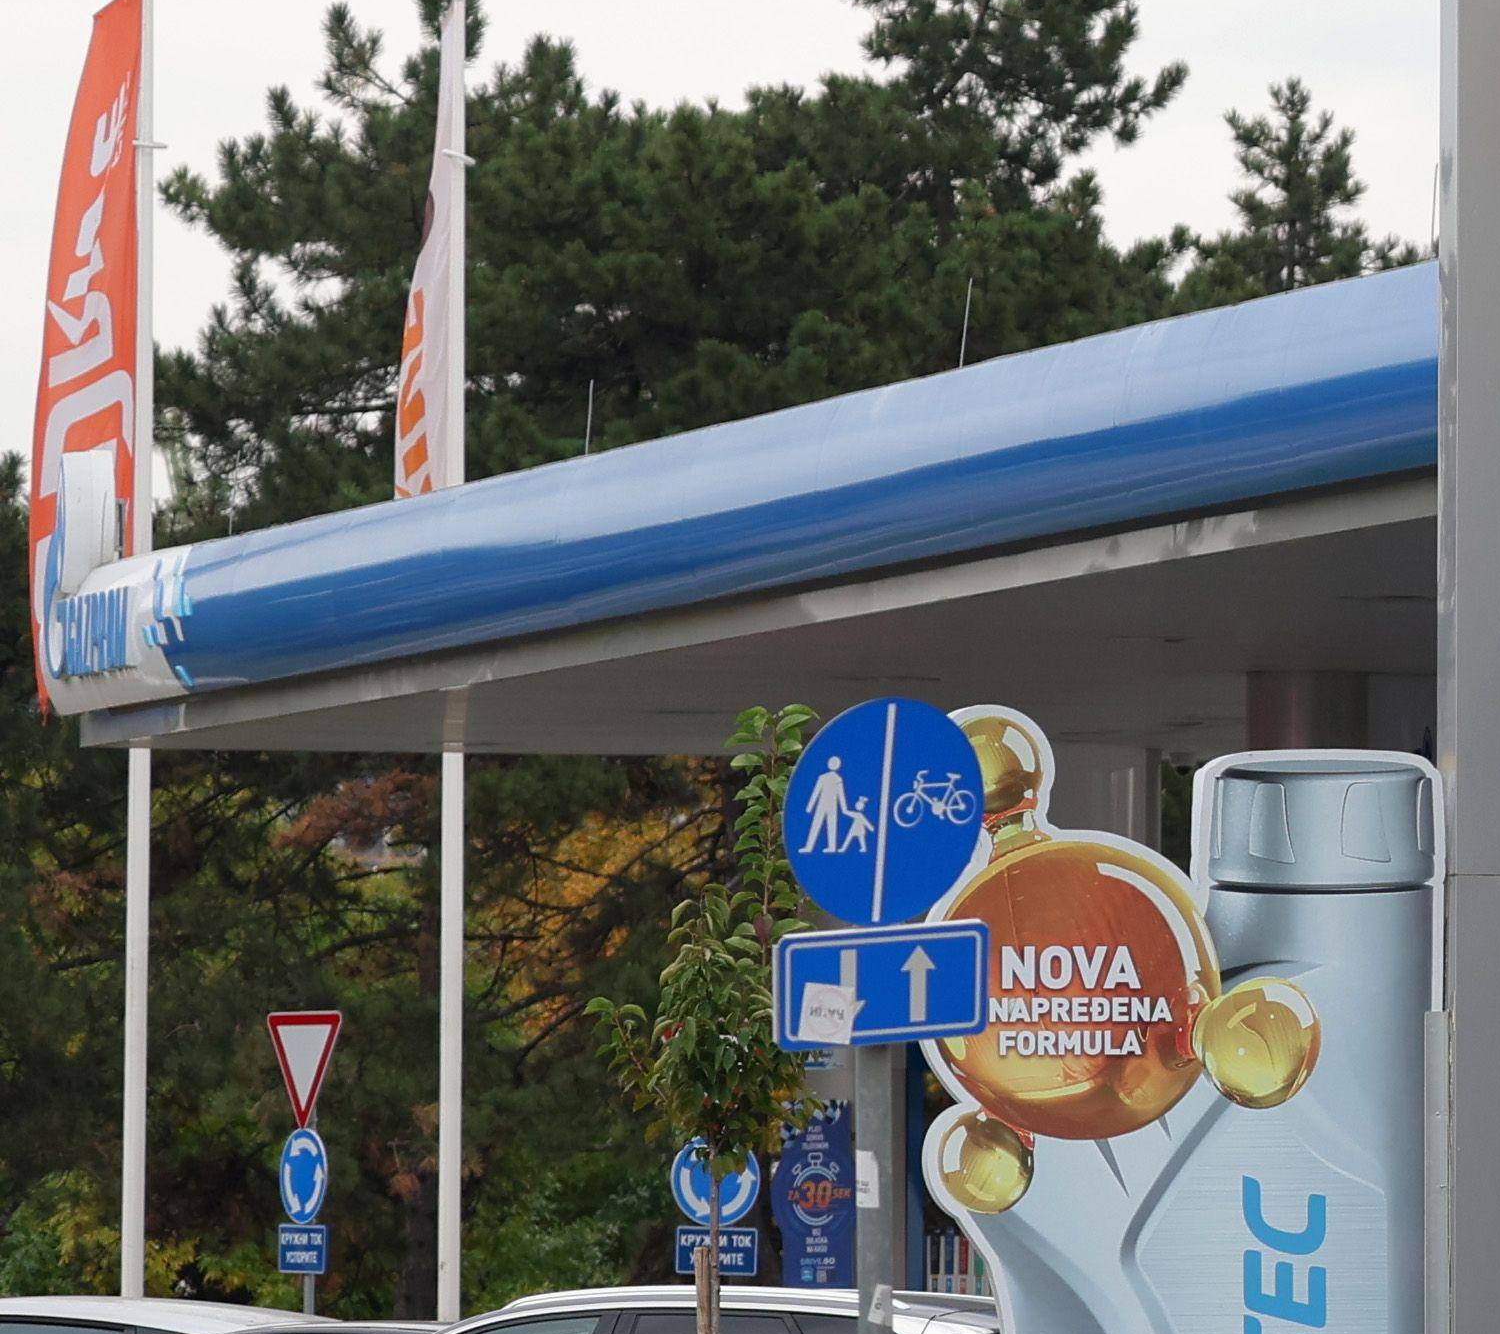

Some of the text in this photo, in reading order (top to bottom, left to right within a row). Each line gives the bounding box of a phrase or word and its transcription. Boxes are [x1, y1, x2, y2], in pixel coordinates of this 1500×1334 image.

[1001, 945, 1142, 990] NOVA
[988, 997, 1173, 1023] NAPREĐENA
[999, 1030, 1142, 1056] FORMULA
[800, 1180, 832, 1208] 30
[680, 1234, 752, 1247] КРУЖИ ТОК
[689, 1252, 744, 1265] УРИТЕ
